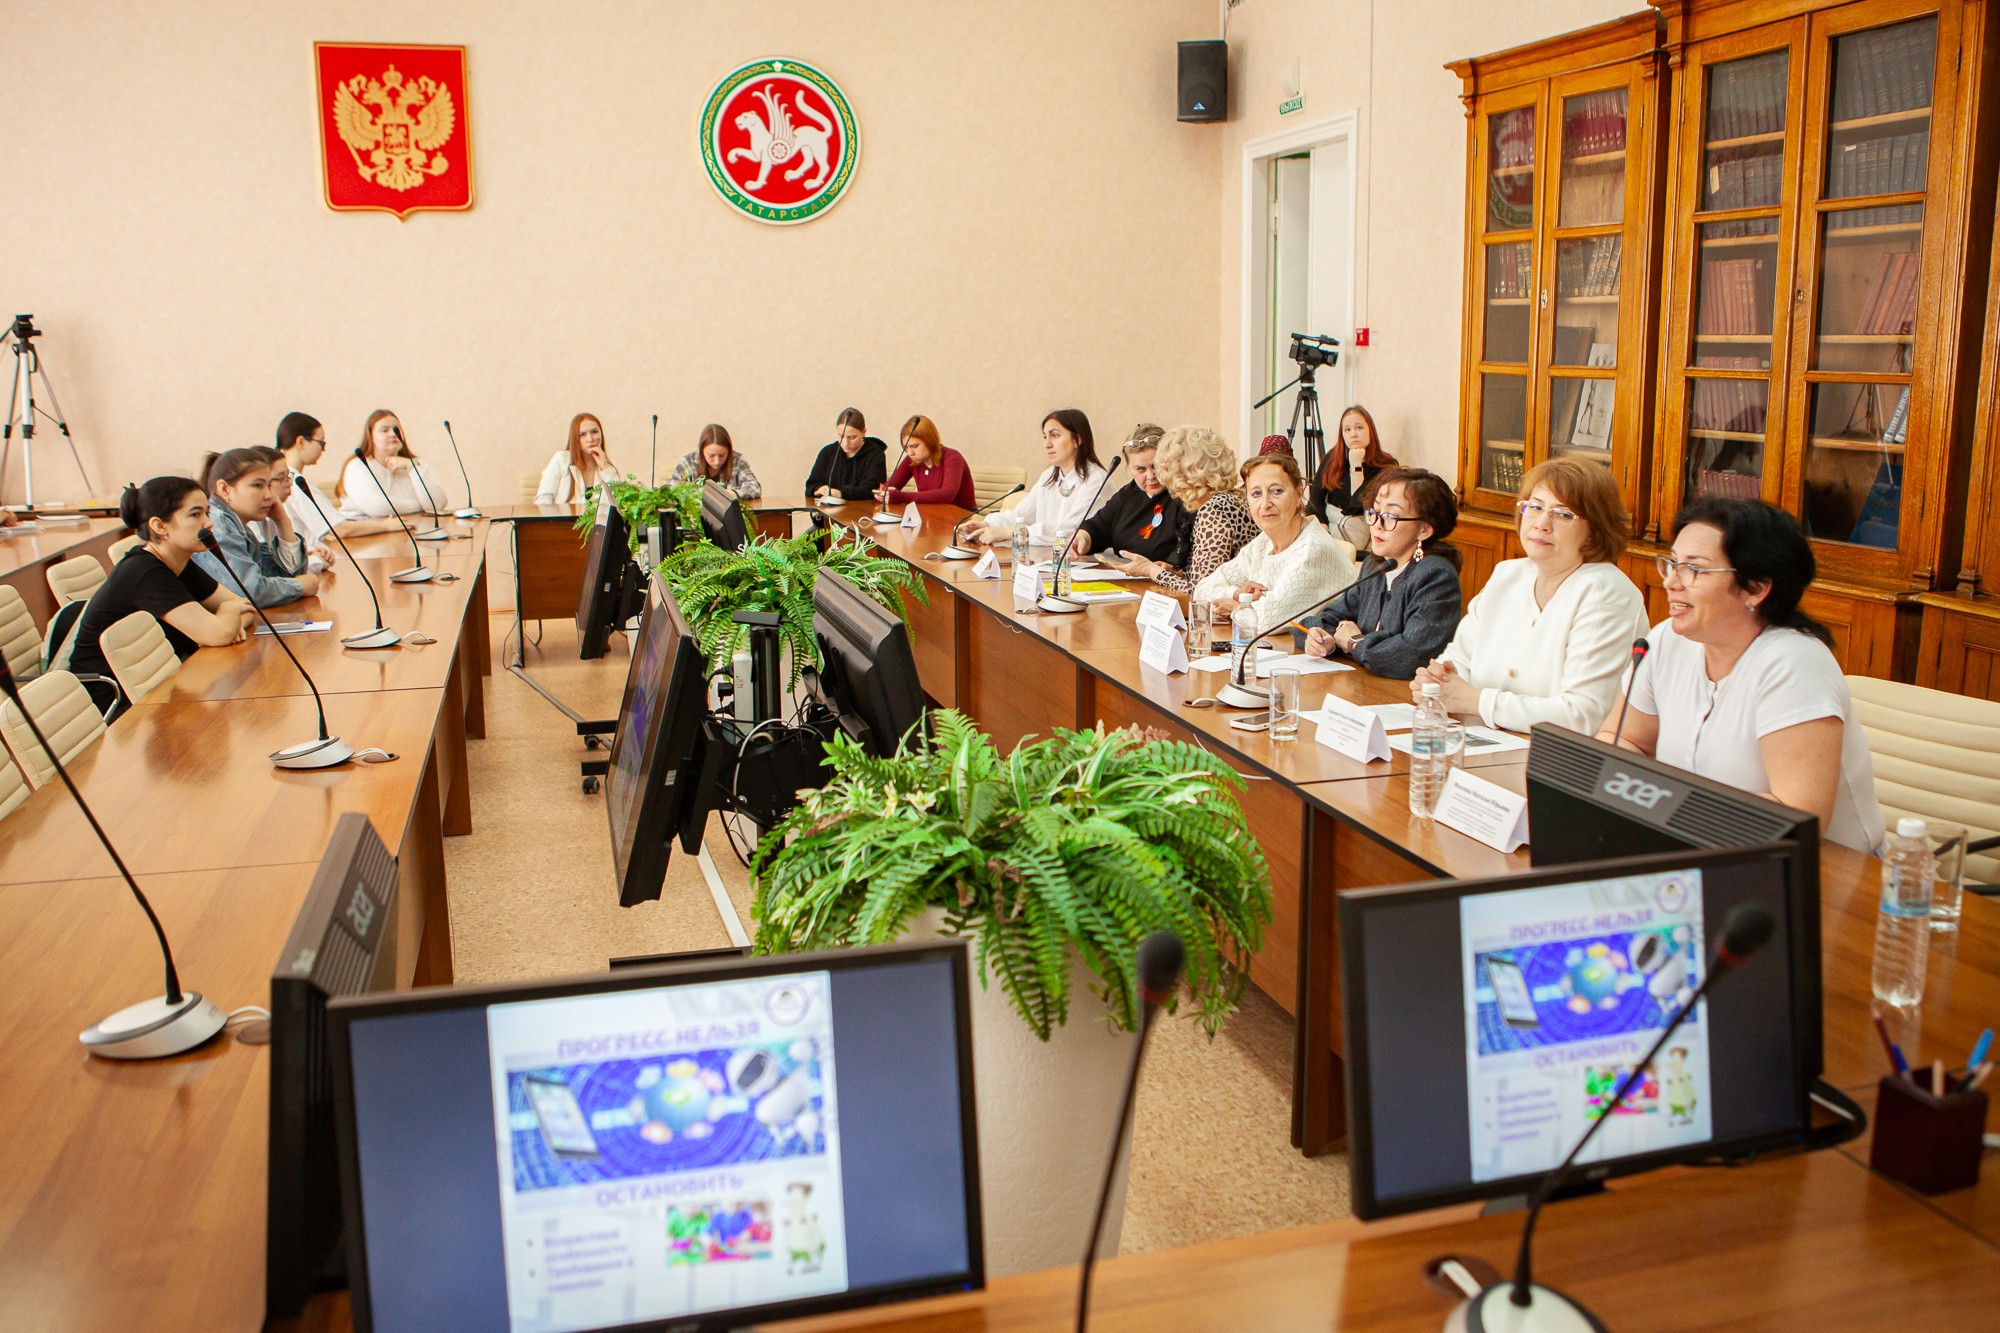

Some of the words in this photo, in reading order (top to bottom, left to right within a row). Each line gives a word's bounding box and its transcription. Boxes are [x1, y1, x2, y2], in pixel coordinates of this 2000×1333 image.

[736, 196, 828, 219] ТАТАРСТАН
[1603, 771, 1673, 810] acer
[345, 881, 376, 937] acer
[557, 1027, 668, 1058] ПРОГРЕСС
[675, 1018, 761, 1046] НЕЛЬЗЯ
[595, 1173, 744, 1207] ОСТАНОВИТЬ
